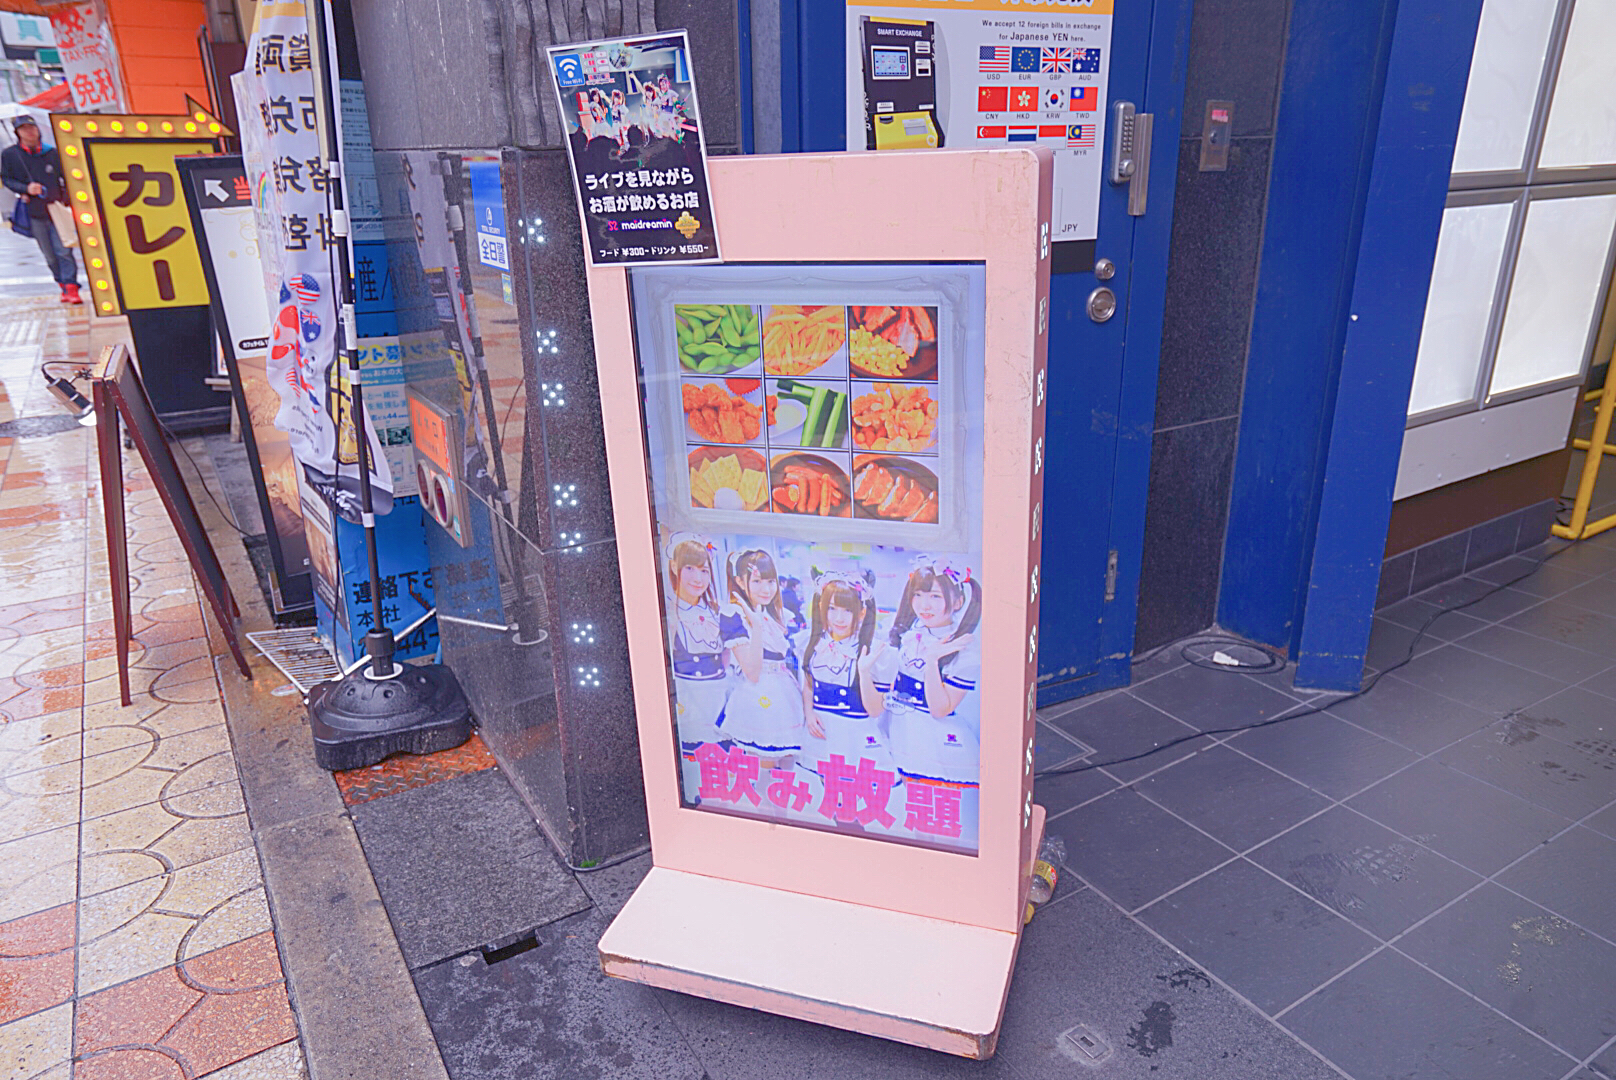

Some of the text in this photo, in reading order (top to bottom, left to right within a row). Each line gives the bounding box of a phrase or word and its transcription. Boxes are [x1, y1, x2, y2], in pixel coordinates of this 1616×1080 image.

[981, 19, 993, 27] We
[994, 20, 1016, 28] accept
[1027, 21, 1049, 29] foreign
[1073, 22, 1101, 30] exchange
[877, 28, 923, 37] SMART EXCHANGE
[1010, 32, 1049, 41] Japanese
[1052, 32, 1069, 42] YEN
[585, 167, 695, 190] ライブを見ながら
[589, 191, 700, 213] お酒が飲めるお店
[621, 218, 673, 230] maidreamin
[1061, 223, 1078, 233] JPY
[108, 163, 187, 302] カレー
[599, 248, 620, 257] フード
[651, 246, 677, 255] ドリンク
[694, 742, 963, 838] 飲み放題
